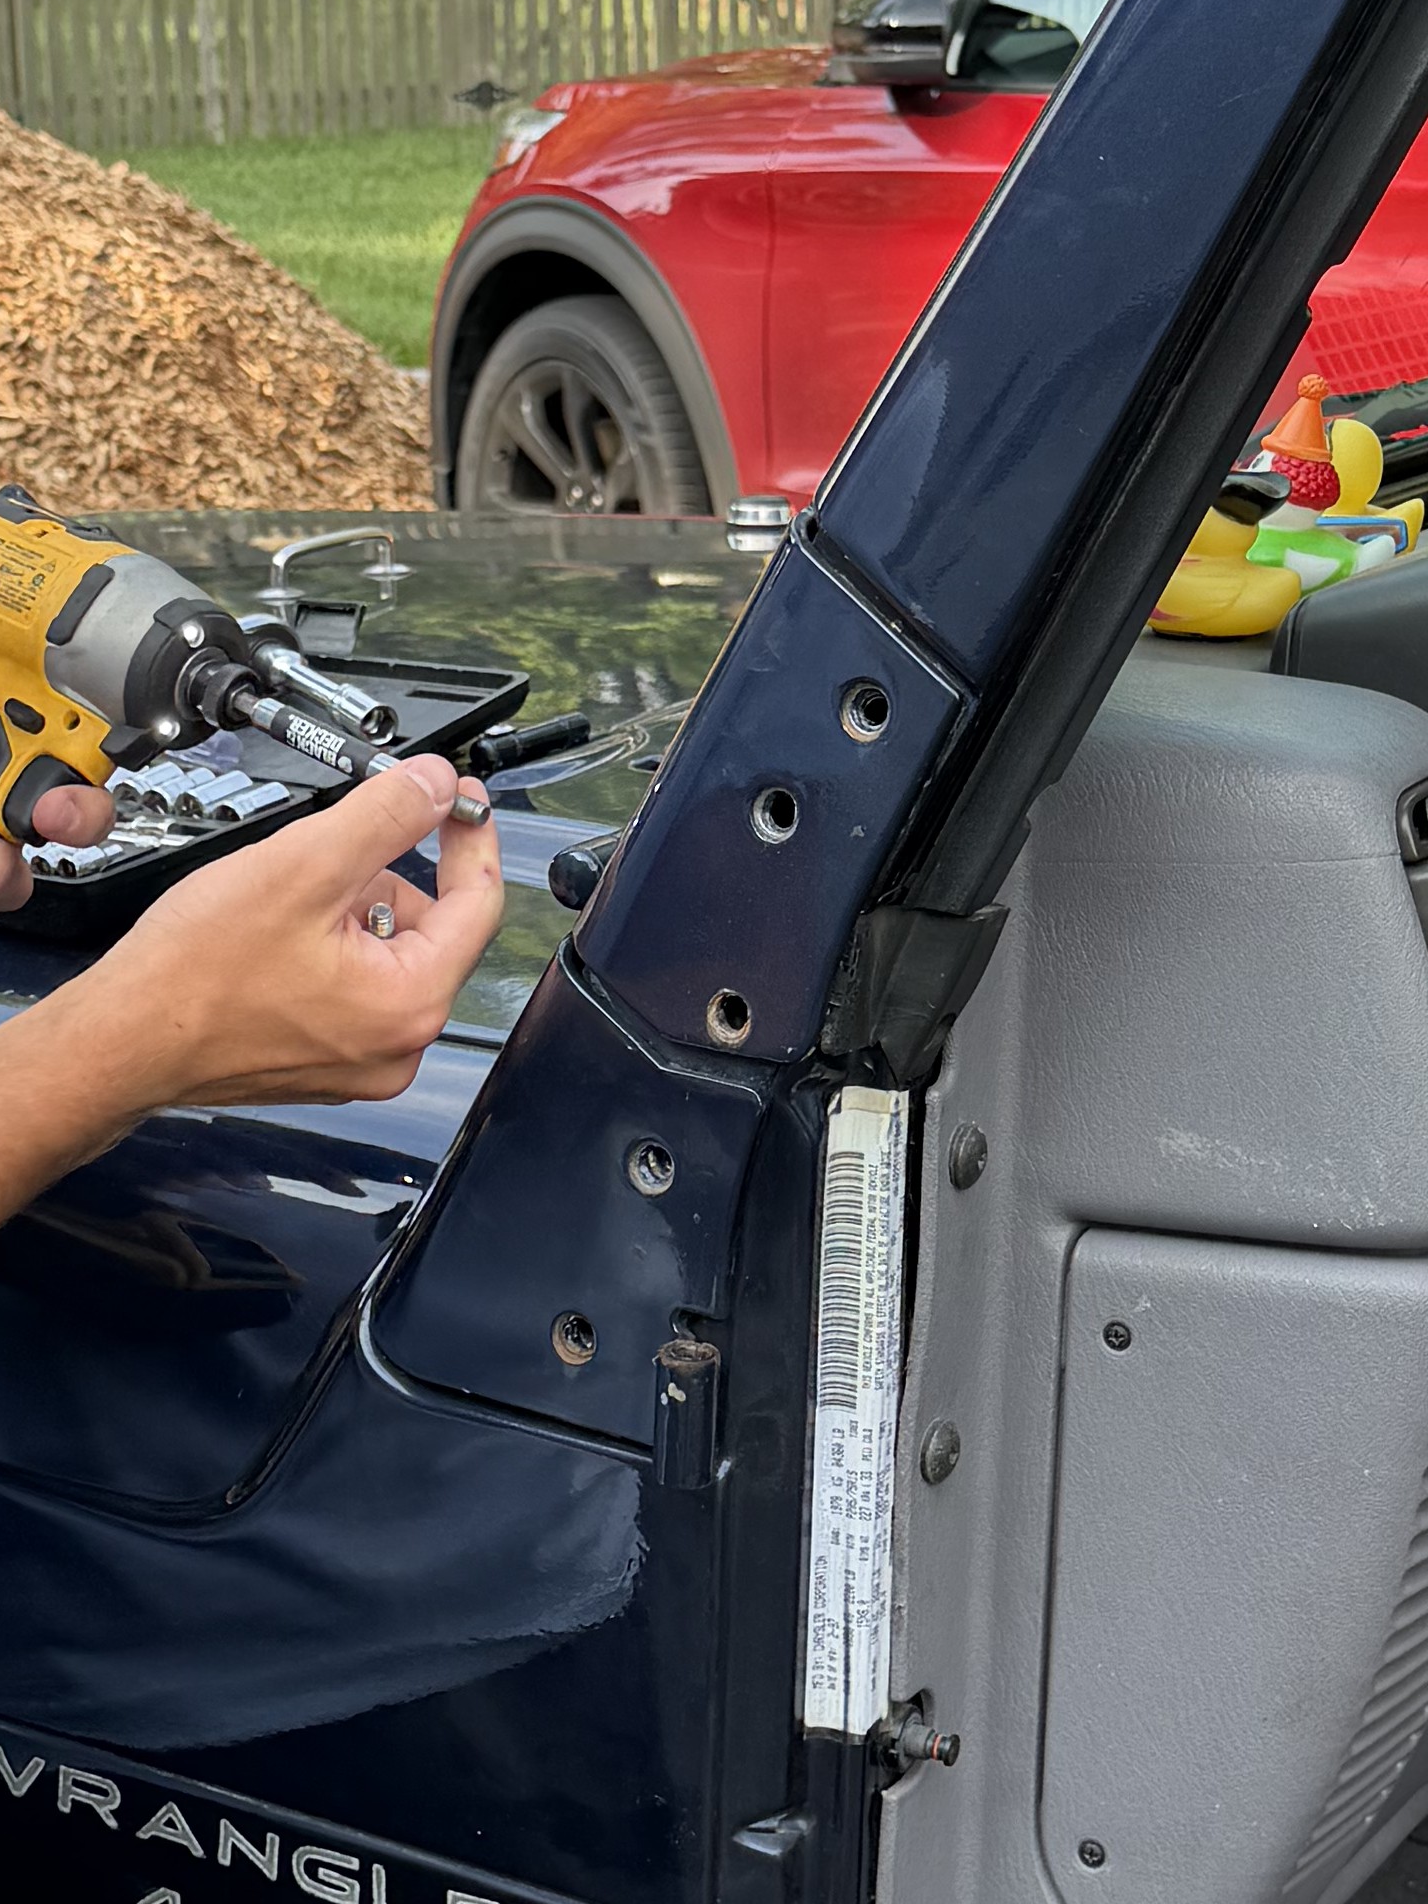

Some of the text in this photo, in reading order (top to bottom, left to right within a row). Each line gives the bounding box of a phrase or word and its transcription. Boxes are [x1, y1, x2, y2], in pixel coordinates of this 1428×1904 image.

[859, 1506, 872, 1521] 227
[814, 1556, 828, 1608] CORPORATION
[813, 1613, 825, 1652] CHRYSLER
